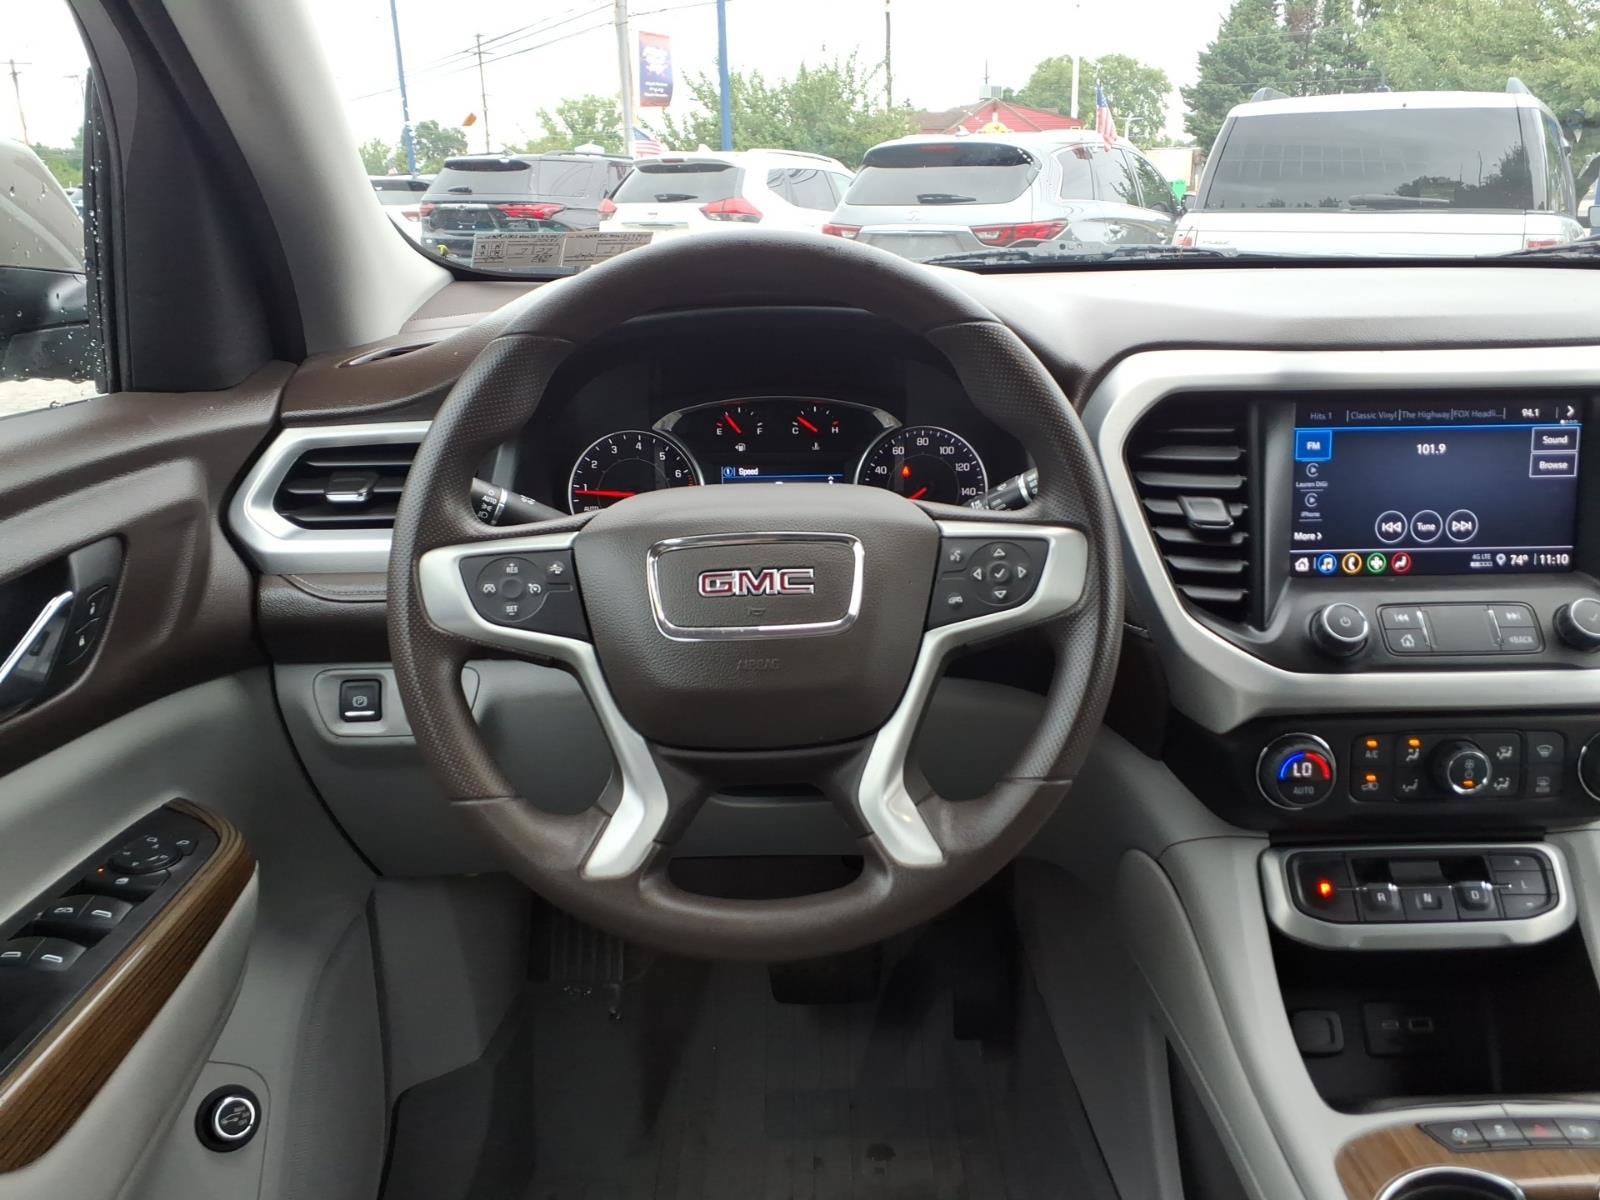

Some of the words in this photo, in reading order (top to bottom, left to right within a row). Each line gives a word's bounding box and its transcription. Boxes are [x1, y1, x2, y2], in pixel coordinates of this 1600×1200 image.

[1310, 411, 1327, 421] Hits
[1328, 411, 1333, 420] 1
[1350, 411, 1377, 421] Classic
[1378, 410, 1398, 421] Vinyl
[1401, 410, 1416, 420] The
[1417, 409, 1450, 421] Highway
[1453, 409, 1470, 419] FOX
[1521, 408, 1541, 418] 94.1
[716, 427, 723, 436] E
[756, 427, 763, 436] F
[791, 426, 800, 435] C
[831, 426, 839, 434] H
[916, 437, 929, 446] 80
[1542, 435, 1569, 445] Sound
[611, 445, 618, 455] 3
[635, 441, 643, 451] 4
[892, 446, 905, 455] 60
[939, 446, 955, 455] 100
[1306, 441, 1321, 451] FM
[1416, 443, 1447, 455] 101.9
[659, 451, 666, 461] 5
[591, 459, 598, 469] 2
[955, 462, 970, 472] 120
[1539, 460, 1569, 471] Browse
[674, 469, 682, 478] 6
[738, 467, 759, 477] Speed
[874, 465, 888, 475] 40
[961, 487, 977, 496] 140
[1416, 522, 1436, 532] Tune
[1293, 531, 1317, 541] More
[1540, 553, 1570, 566] 11:10
[506, 566, 519, 574] RES
[698, 568, 815, 597] GMC
[506, 605, 519, 613] SET
[1293, 762, 1313, 777] LO
[1293, 786, 1315, 795] AUTO
[1377, 892, 1387, 902] R
[1423, 893, 1433, 904] N
[1470, 889, 1481, 900] D
